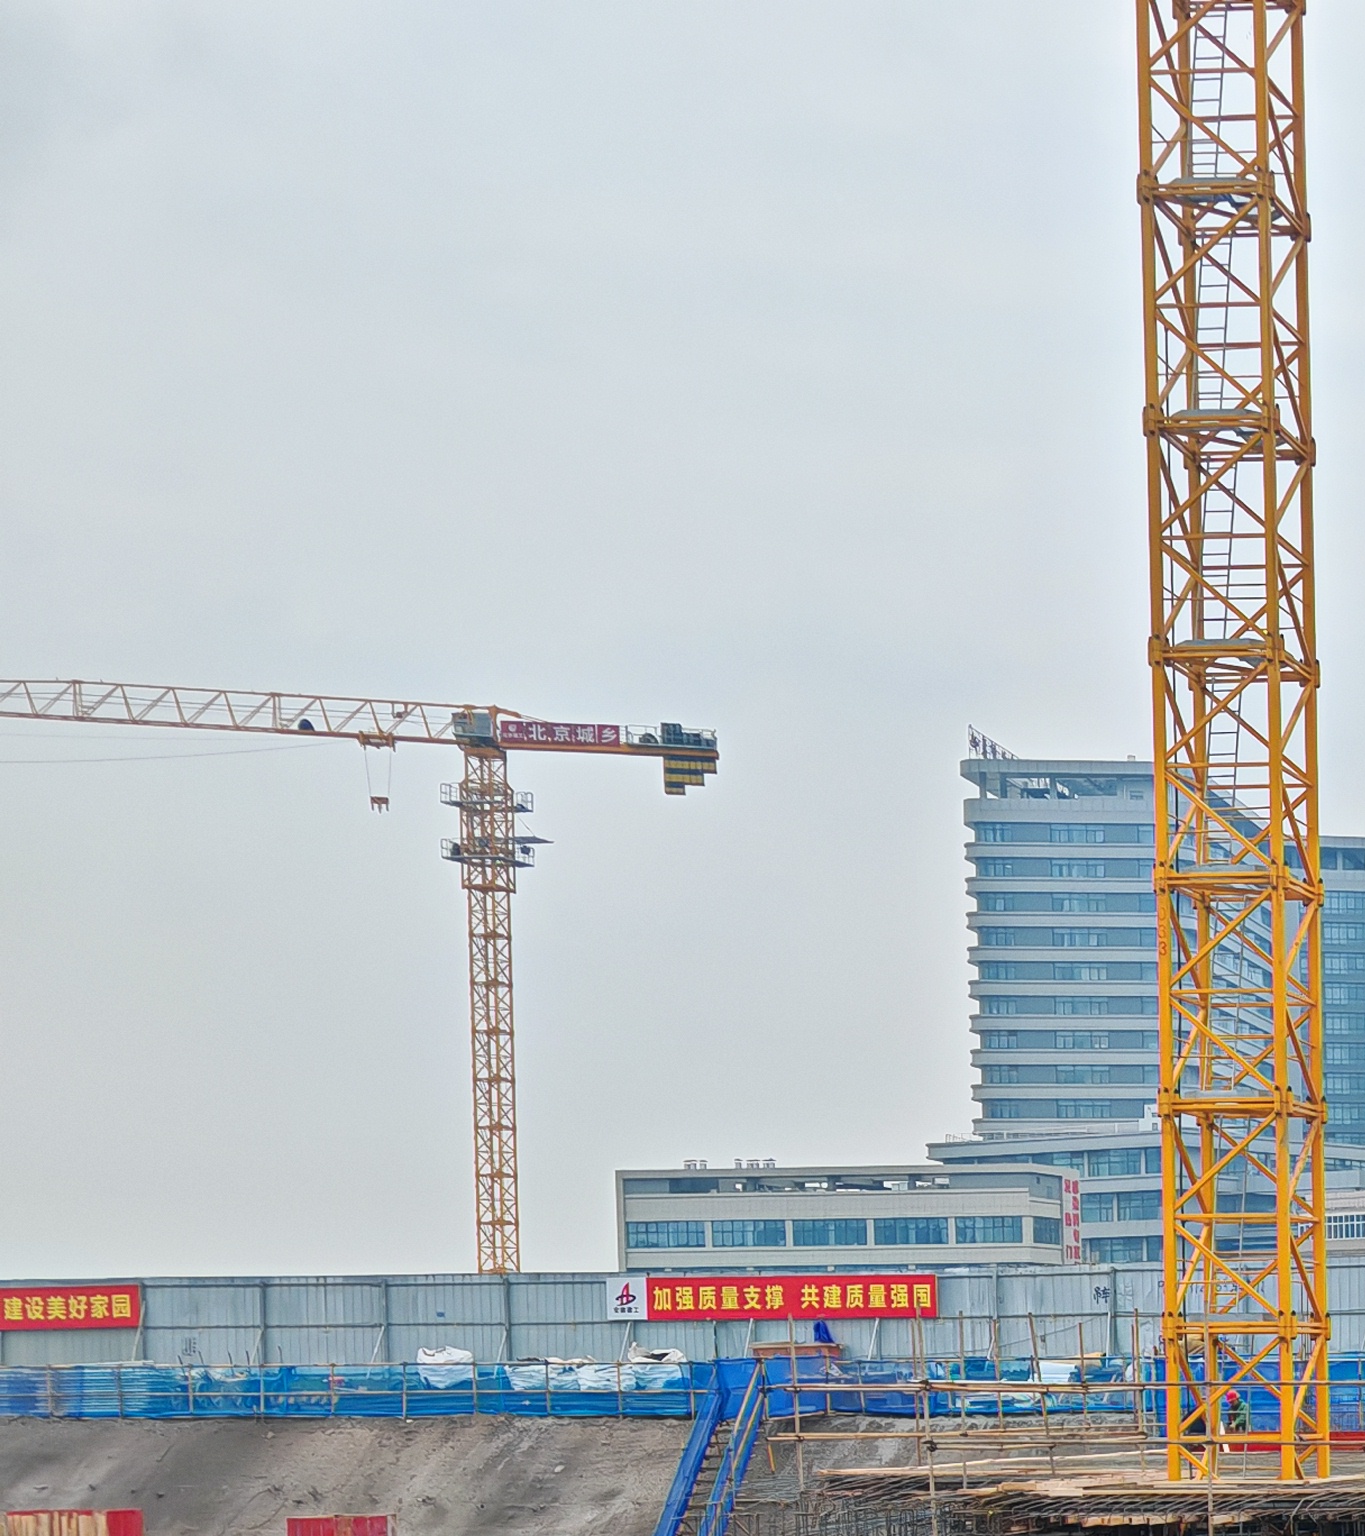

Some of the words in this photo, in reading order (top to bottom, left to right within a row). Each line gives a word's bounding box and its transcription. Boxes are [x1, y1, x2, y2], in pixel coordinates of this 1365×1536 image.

[528, 723, 617, 743] 北京城乡
[3, 1295, 131, 1320] 建设美好家园
[653, 1284, 785, 1311] 加强质量支撑
[801, 1283, 932, 1309] 共建质量强国
